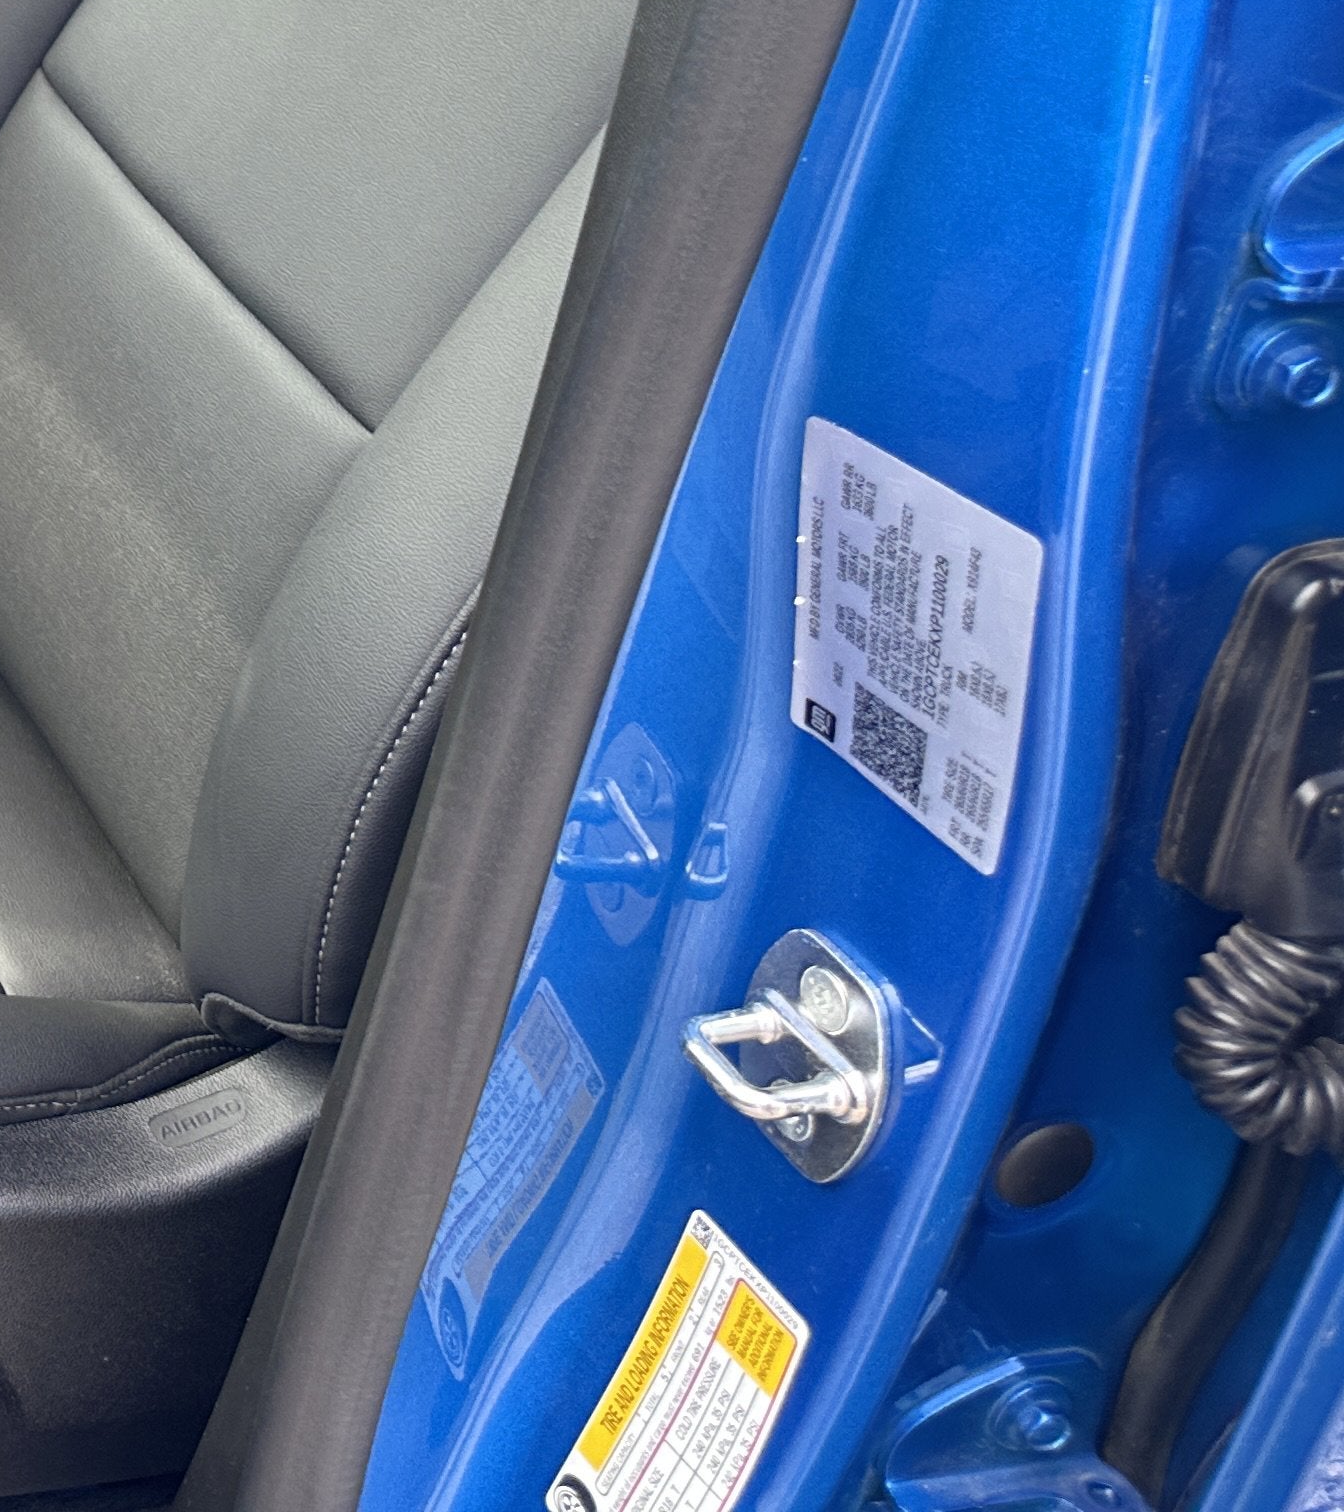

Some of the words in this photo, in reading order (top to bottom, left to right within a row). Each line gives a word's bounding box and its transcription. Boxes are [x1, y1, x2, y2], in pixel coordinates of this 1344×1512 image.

[842, 459, 853, 479] RR
[853, 470, 864, 490] KG
[865, 478, 876, 498] LB
[812, 494, 824, 519] LLC
[840, 477, 852, 511] GAWR
[810, 514, 824, 560] MOTORS
[837, 530, 848, 553] FRT
[874, 522, 886, 546] ALL
[885, 522, 899, 564] MOTOR
[899, 501, 914, 545] EFFECT
[836, 549, 848, 584] GAWR
[873, 543, 885, 562] TO
[809, 556, 823, 606] GENERAL
[869, 558, 885, 617] CONFORMS
[881, 560, 896, 609] FEDERAL
[893, 553, 910, 617] STANDARDS
[904, 548, 923, 626] MANUFACTURE
[809, 601, 820, 620] BY
[866, 614, 880, 658] VEHICLE
[890, 614, 904, 655] SAFETY
[901, 637, 914, 667] DATE
[903, 623, 915, 642] OF
[918, 552, 953, 721] 1GCPTCEKXP1100029
[865, 654, 877, 680] THIS
[875, 626, 892, 688] APPLICABLE
[887, 651, 902, 696] VEHICLE
[899, 664, 912, 687] THE
[898, 684, 910, 704] ON
[909, 671, 923, 711] SHOWN
[939, 661, 953, 699] TRUCK
[159, 1097, 242, 1140] AIRBAG
[645, 1271, 692, 1348] INFORMATION
[690, 1340, 705, 1363] 691
[711, 1287, 730, 1317] 1523
[725, 1329, 740, 1351] SEE
[734, 1322, 758, 1360] MANUAL
[749, 1305, 765, 1328] FOR
[745, 1319, 775, 1368] ADDITIONAL
[622, 1336, 659, 1394] LOADING
[753, 1326, 788, 1382] INFORMATION
[612, 1381, 635, 1414] AND
[693, 1355, 723, 1402] PRESSURE
[600, 1403, 624, 1437] TIRE
[674, 1413, 693, 1442] COLD
[686, 1397, 702, 1419] TIRE
[690, 1437, 706, 1460] 240
[716, 1387, 731, 1408] PSI
[705, 1452, 721, 1475] 240
[731, 1402, 746, 1424] PSI
[647, 1464, 664, 1489] SIZE
